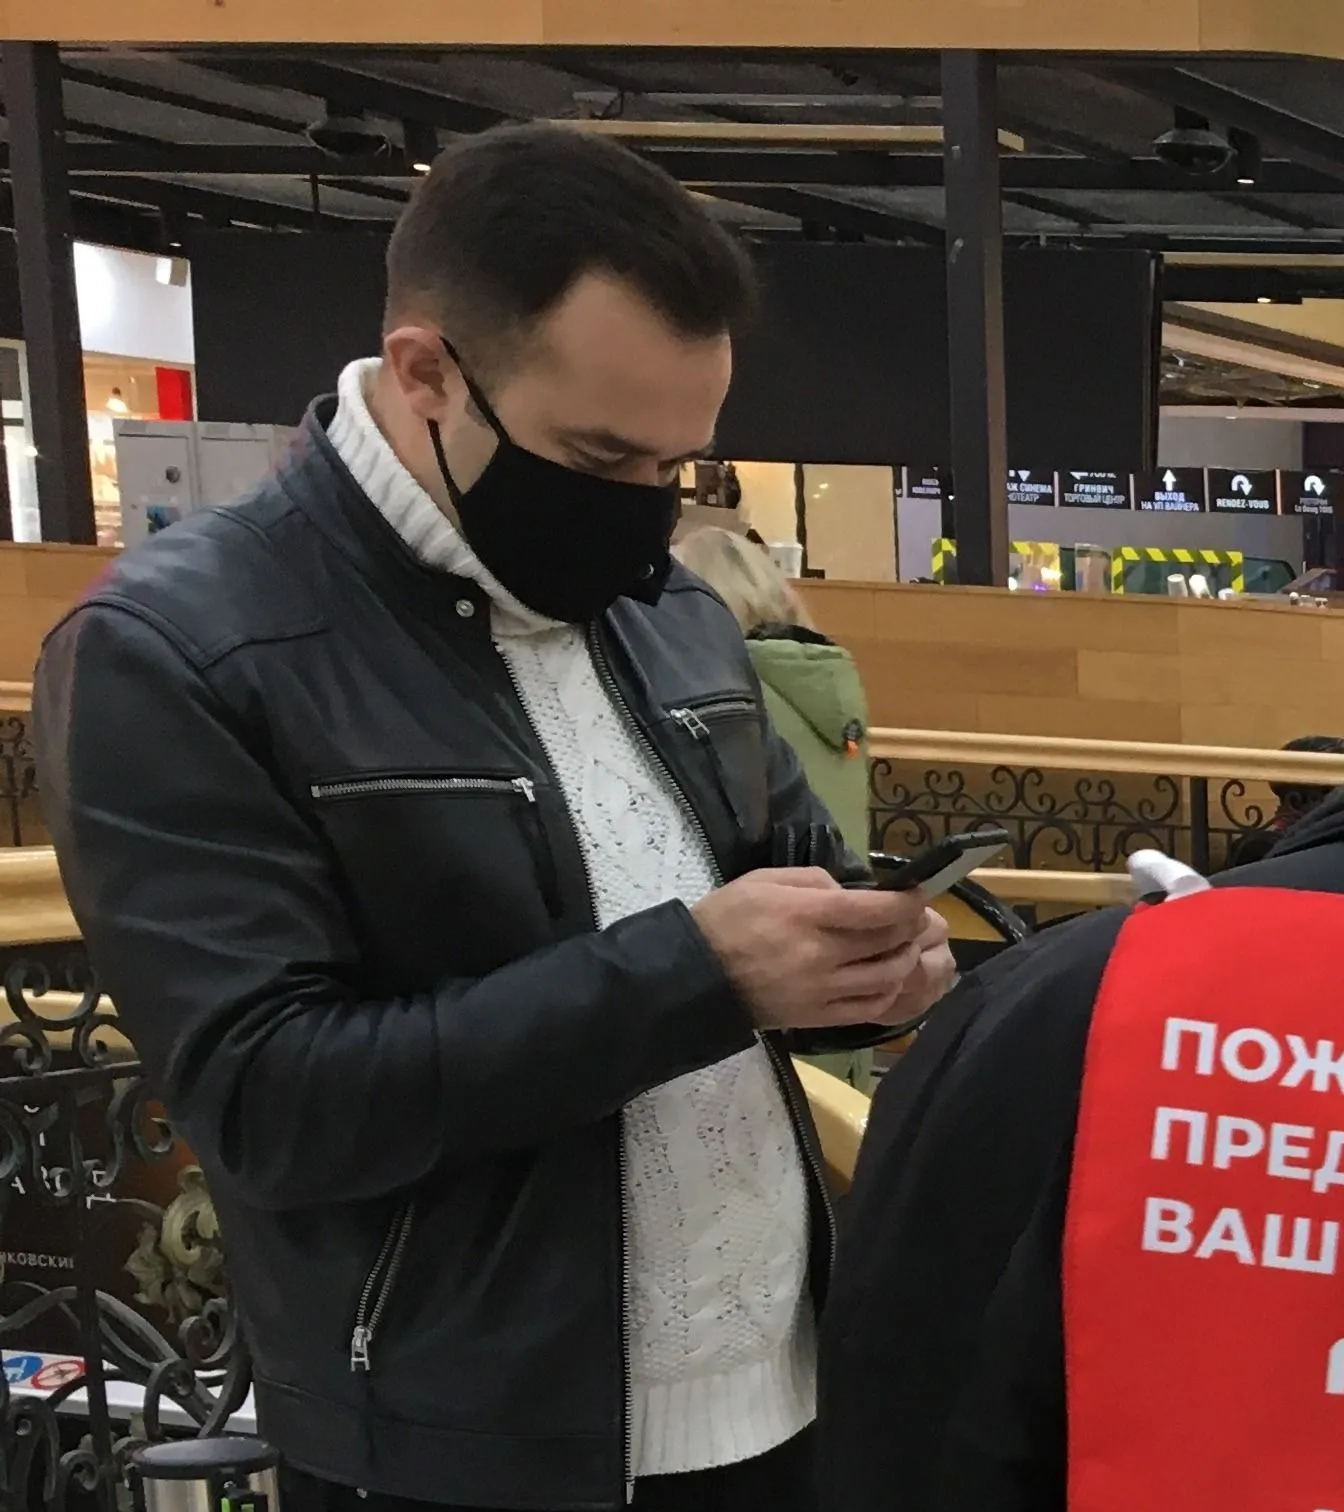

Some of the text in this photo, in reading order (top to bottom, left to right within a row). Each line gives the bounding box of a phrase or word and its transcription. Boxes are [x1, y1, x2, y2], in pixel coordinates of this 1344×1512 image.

[1154, 491, 1185, 502] ВЫХОД
[1216, 498, 1269, 510] RENDEZ-VOUS
[1141, 1196, 1340, 1275] ВАШ
